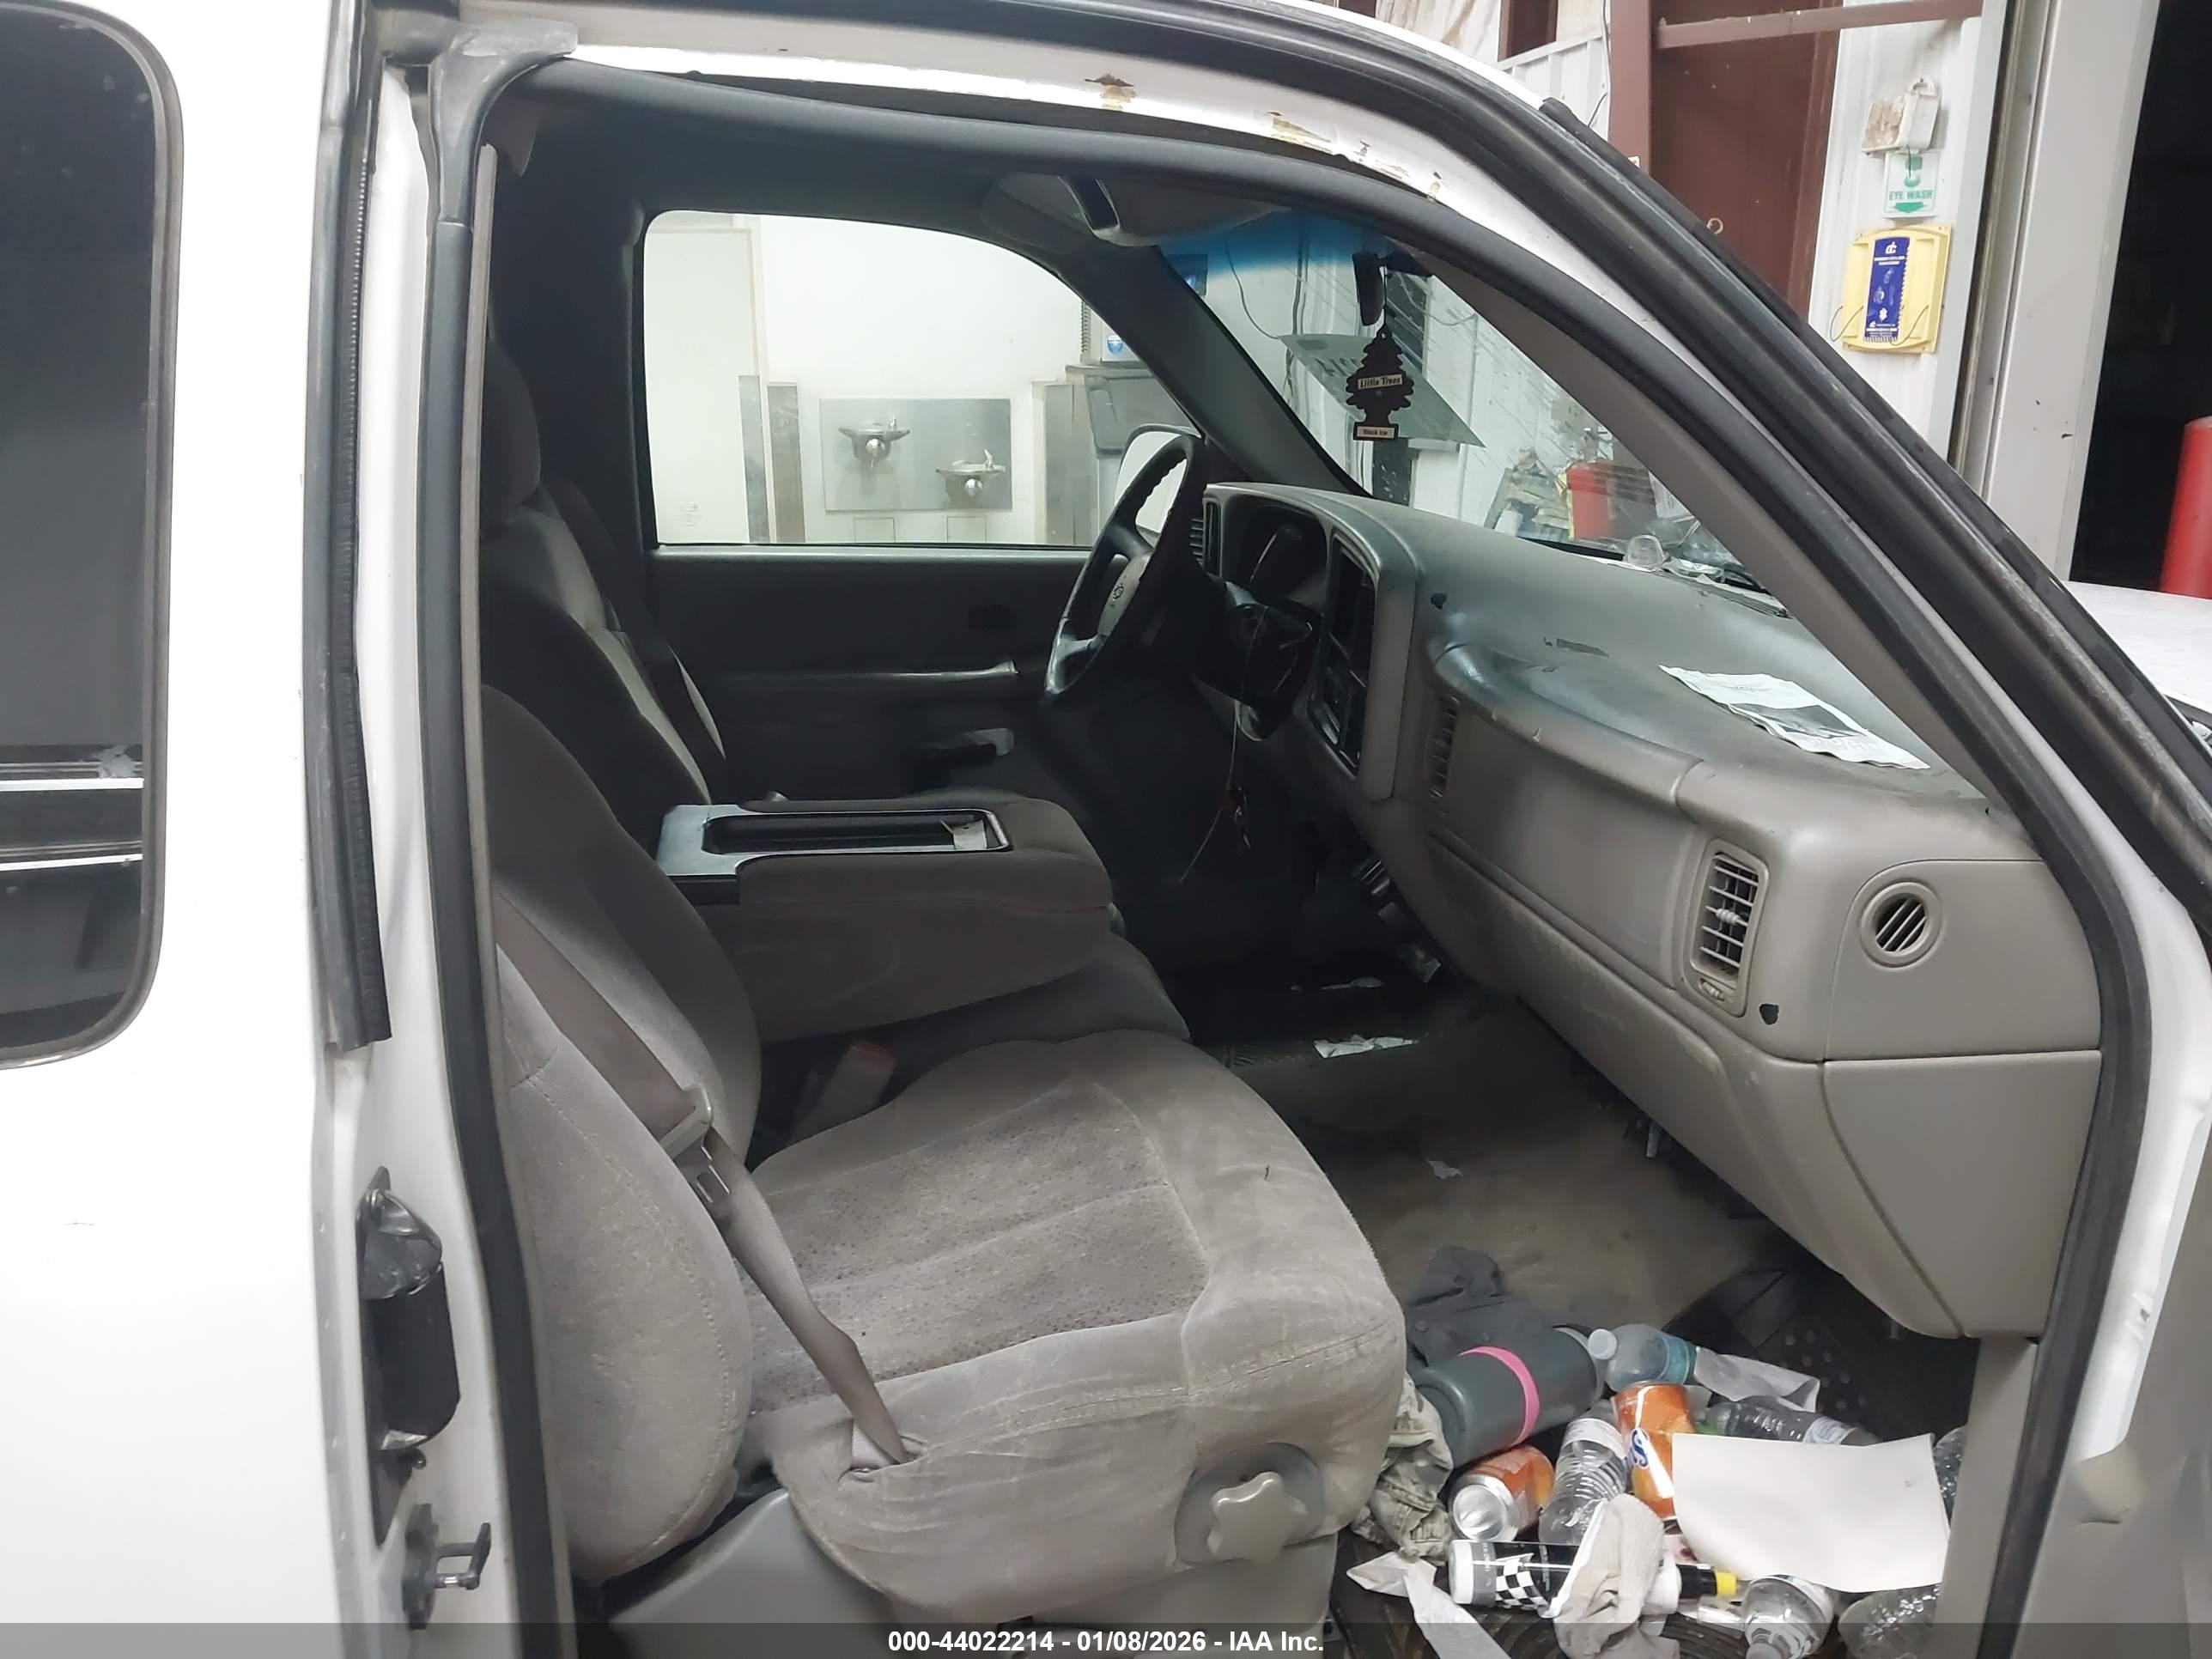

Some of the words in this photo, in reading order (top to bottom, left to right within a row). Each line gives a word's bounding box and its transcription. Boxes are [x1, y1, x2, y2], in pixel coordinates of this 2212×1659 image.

[1889, 191, 1904, 201] EYE
[1907, 190, 1933, 200] WASH
[1360, 378, 1379, 388] Little
[1382, 376, 1401, 386] Trees
